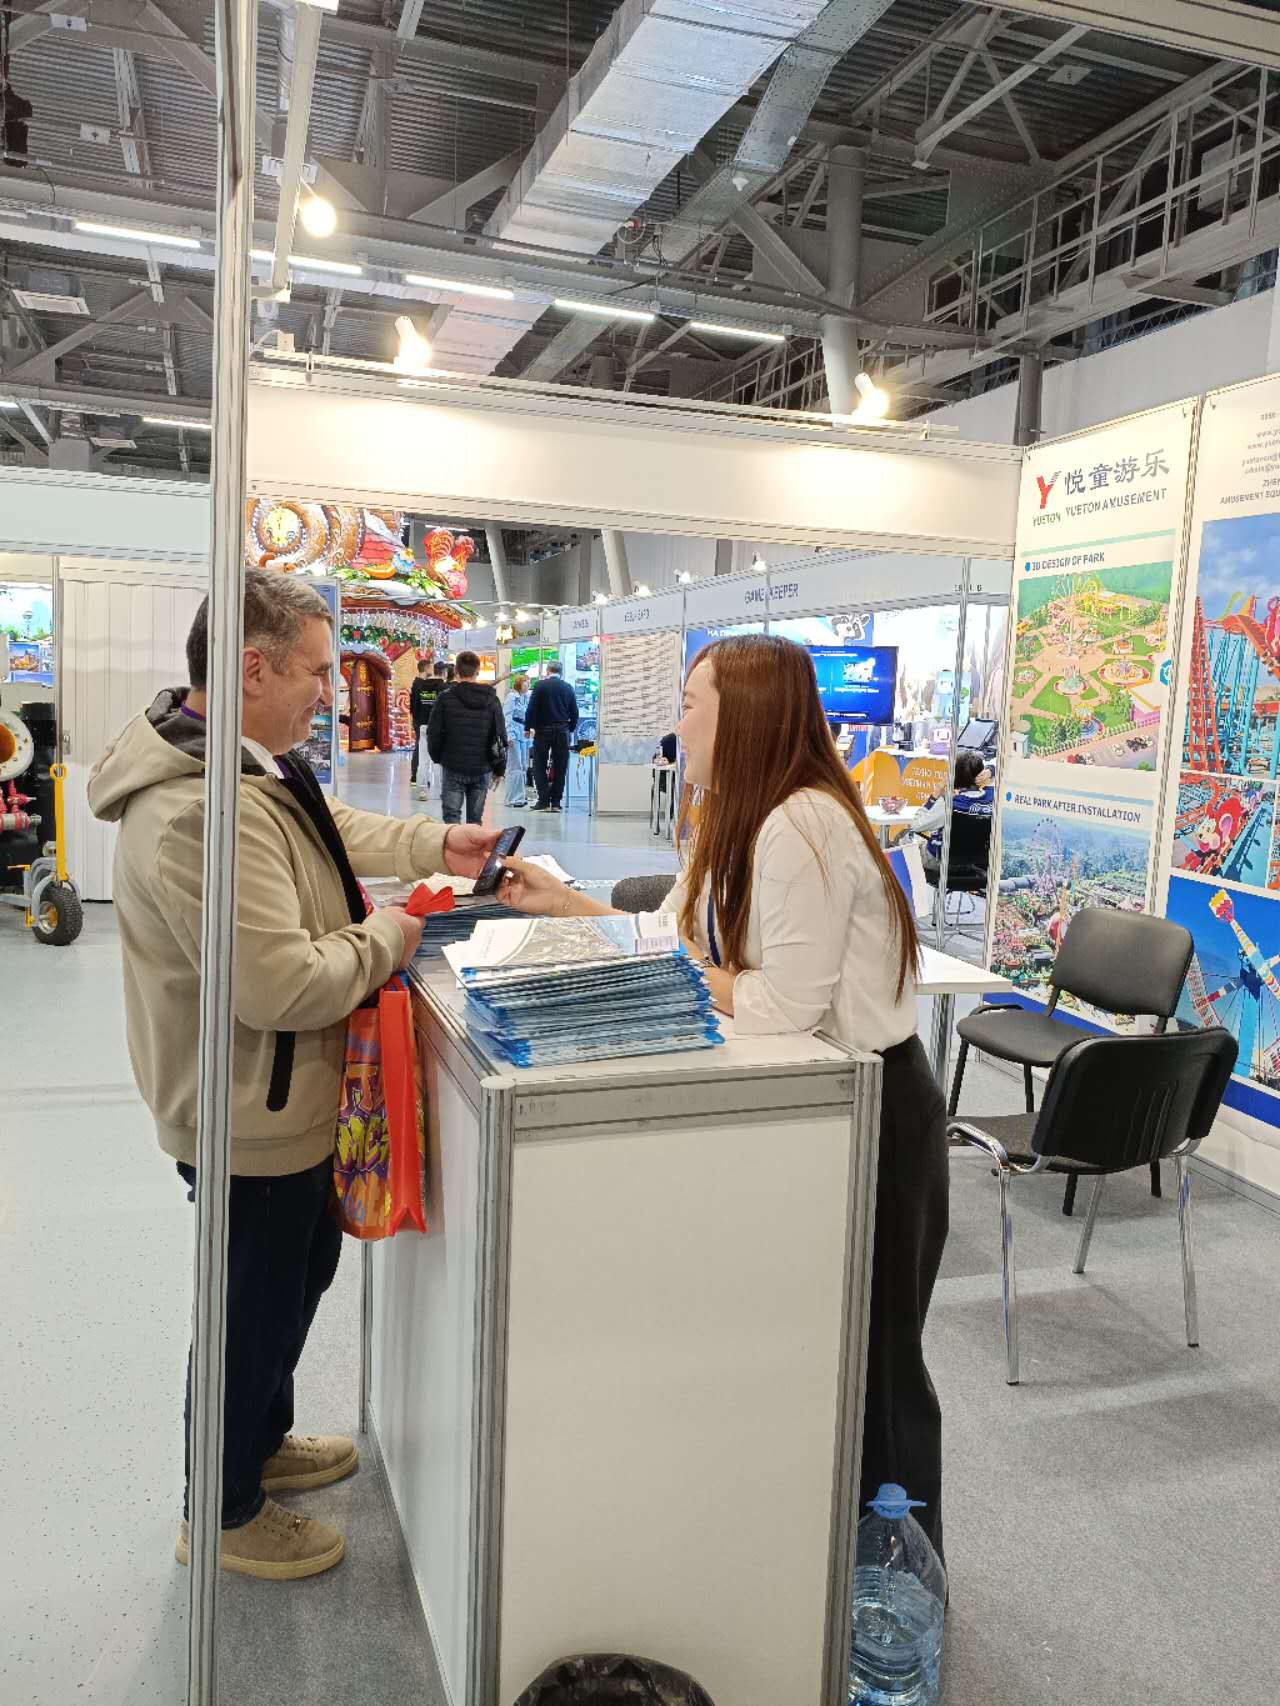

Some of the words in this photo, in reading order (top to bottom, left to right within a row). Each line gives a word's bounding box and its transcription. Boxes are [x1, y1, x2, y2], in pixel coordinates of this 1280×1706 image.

[1064, 448, 1170, 495] 悦童游乐
[1065, 500, 1101, 517] YUETON
[1102, 487, 1168, 511] AMUSEMENT
[1219, 491, 1263, 504] AMUSEMENT
[1032, 512, 1061, 527] YUETON
[1042, 557, 1072, 570] DESIGN
[1072, 555, 1082, 567] OF
[1083, 552, 1105, 565] PARK
[1015, 794, 1032, 805] REAL
[1033, 799, 1052, 808] PARK
[1053, 801, 1076, 813] AFTER
[1078, 804, 1141, 823] INSTALLATION
